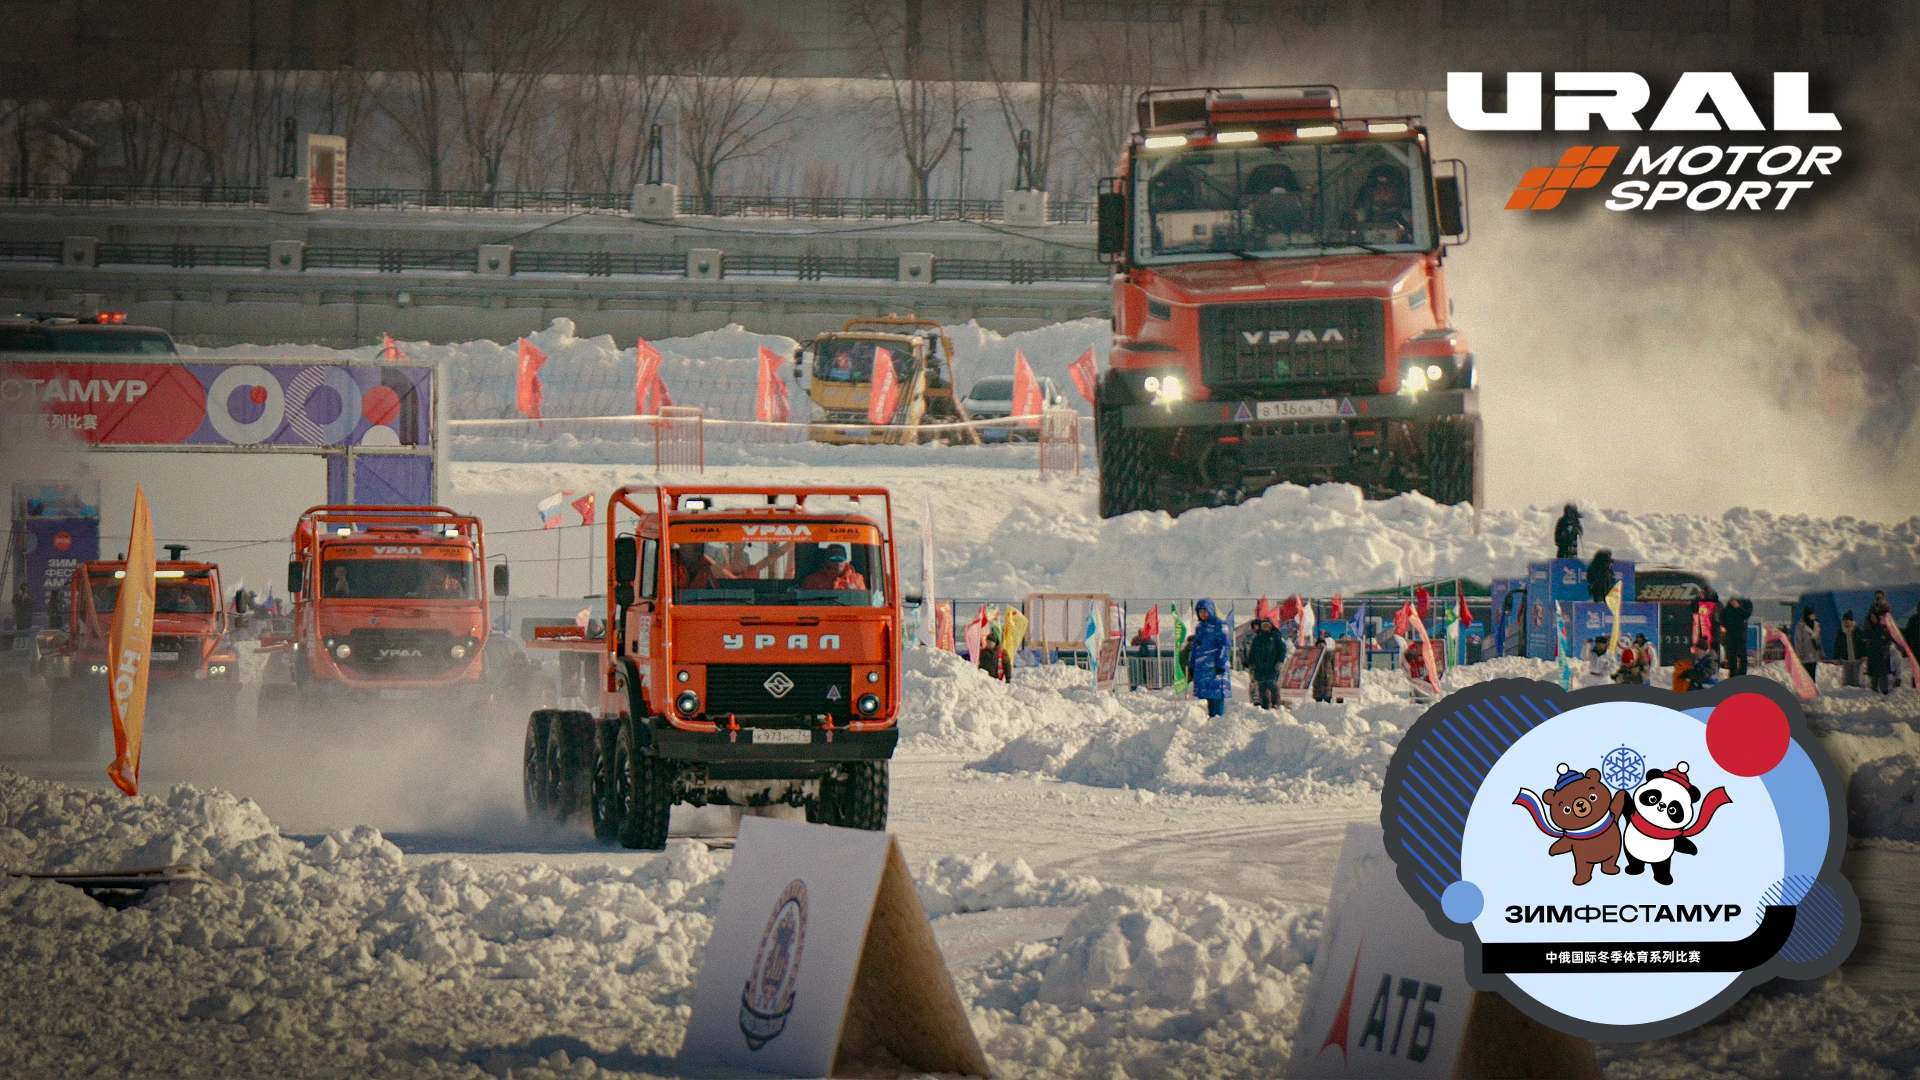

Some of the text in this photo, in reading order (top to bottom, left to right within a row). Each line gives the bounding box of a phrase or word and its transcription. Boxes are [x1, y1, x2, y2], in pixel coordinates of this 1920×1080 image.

[1242, 328, 1344, 344] УРАЛ
[742, 525, 812, 536] УРАЛ
[374, 546, 423, 555] УРАЛ
[722, 633, 840, 650] УРАЛ
[380, 648, 423, 657] УРАЛ
[1359, 973, 1443, 1062] АТБ
